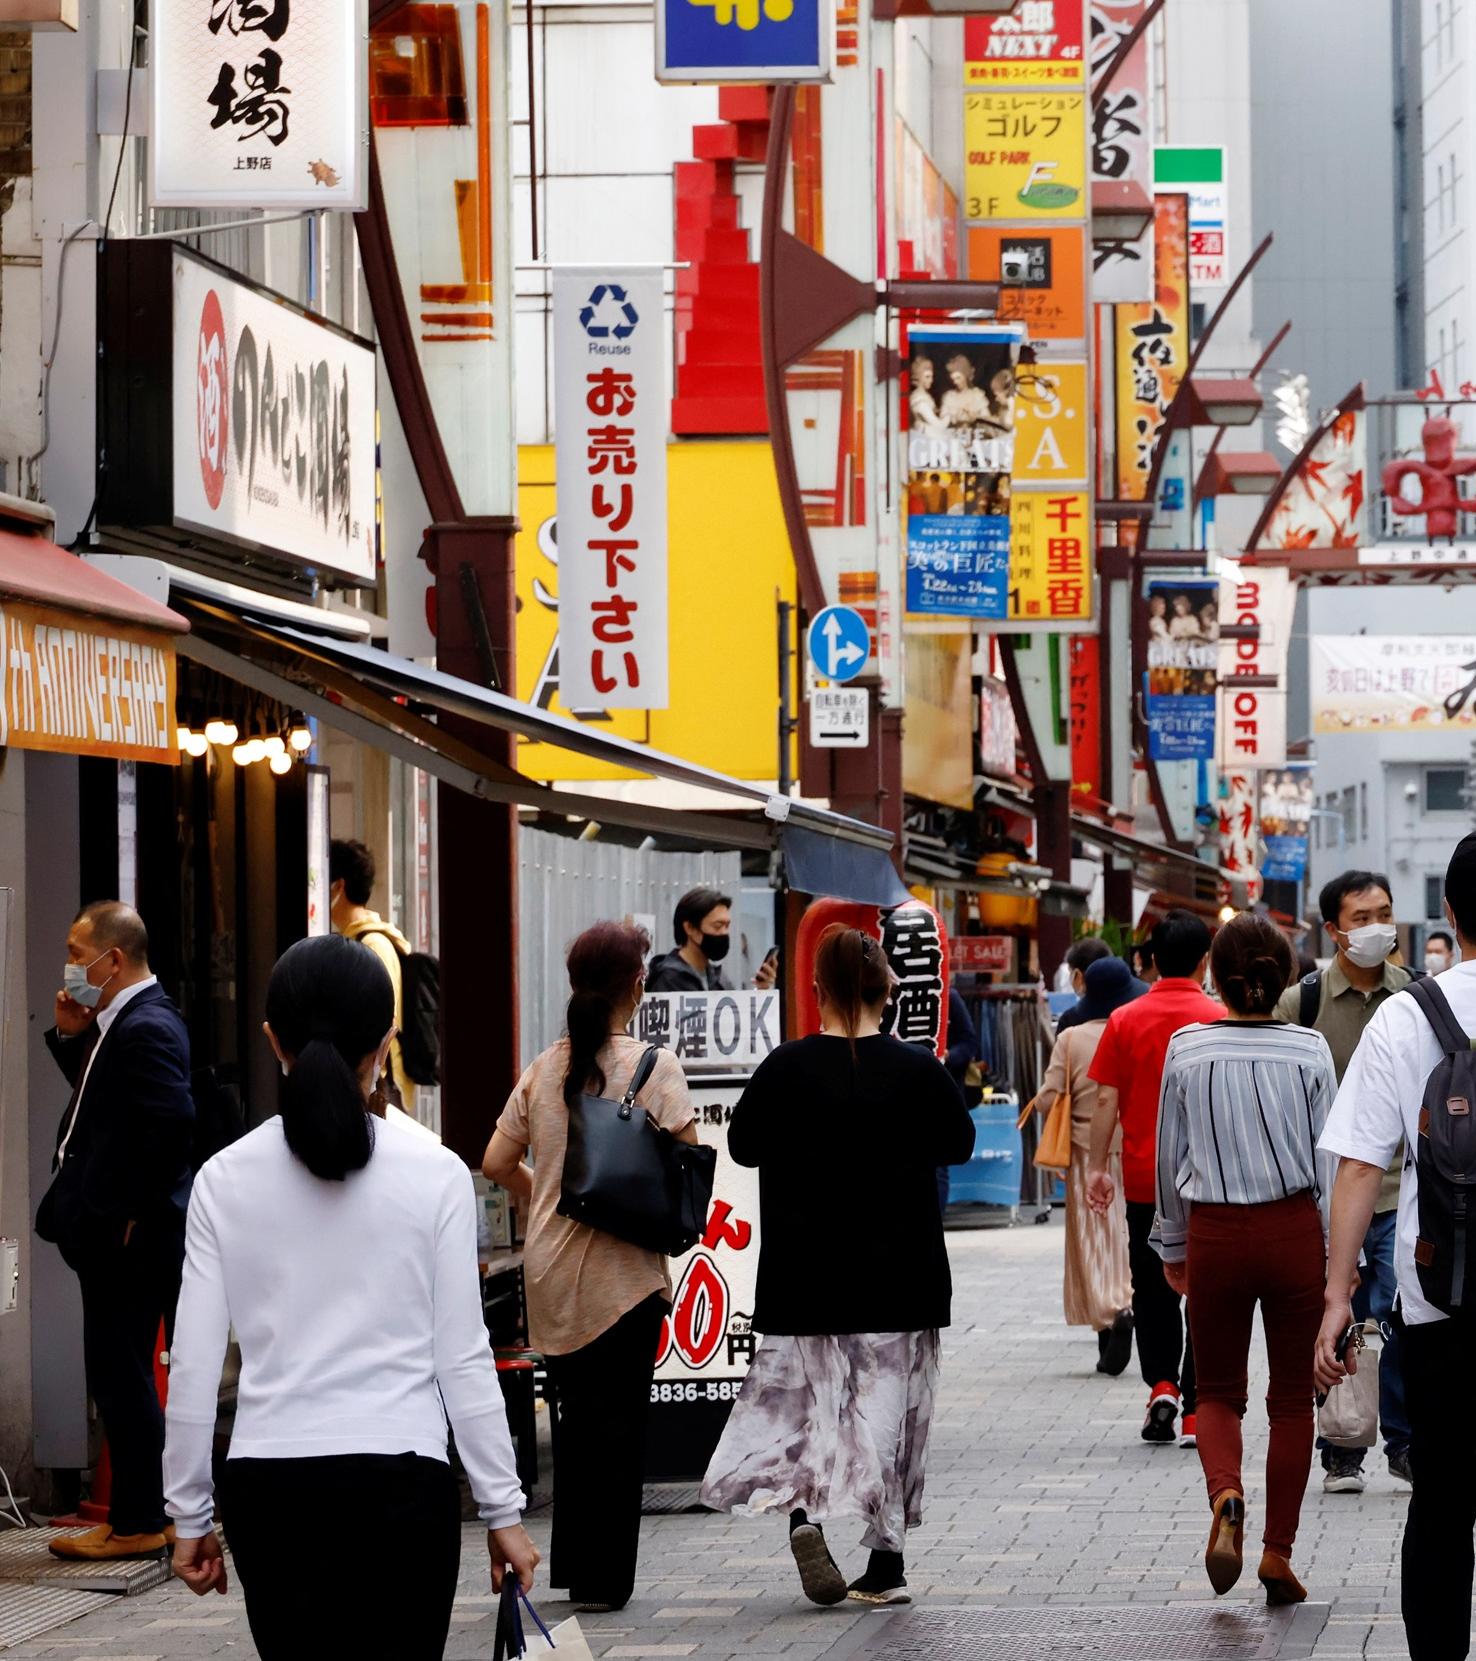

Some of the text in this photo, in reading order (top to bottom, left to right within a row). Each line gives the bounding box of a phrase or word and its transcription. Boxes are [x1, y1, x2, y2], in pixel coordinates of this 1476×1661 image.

[984, 34, 1057, 57] NEXT
[1060, 45, 1081, 59] 4F
[967, 97, 1082, 110] シミュレーション
[987, 115, 1062, 138] ゴルフ
[233, 157, 272, 170] 上野店
[968, 151, 1031, 165] GOLF PARK
[968, 198, 999, 217] 3F
[588, 341, 631, 356] Reuse
[586, 366, 641, 695] お売り下さい
[1045, 496, 1082, 616] 千里香
[34, 623, 168, 749] ANNIVERSARY
[815, 711, 865, 725] 一方通行
[1234, 692, 1259, 756] OFF
[727, 1333, 756, 1366] 円
